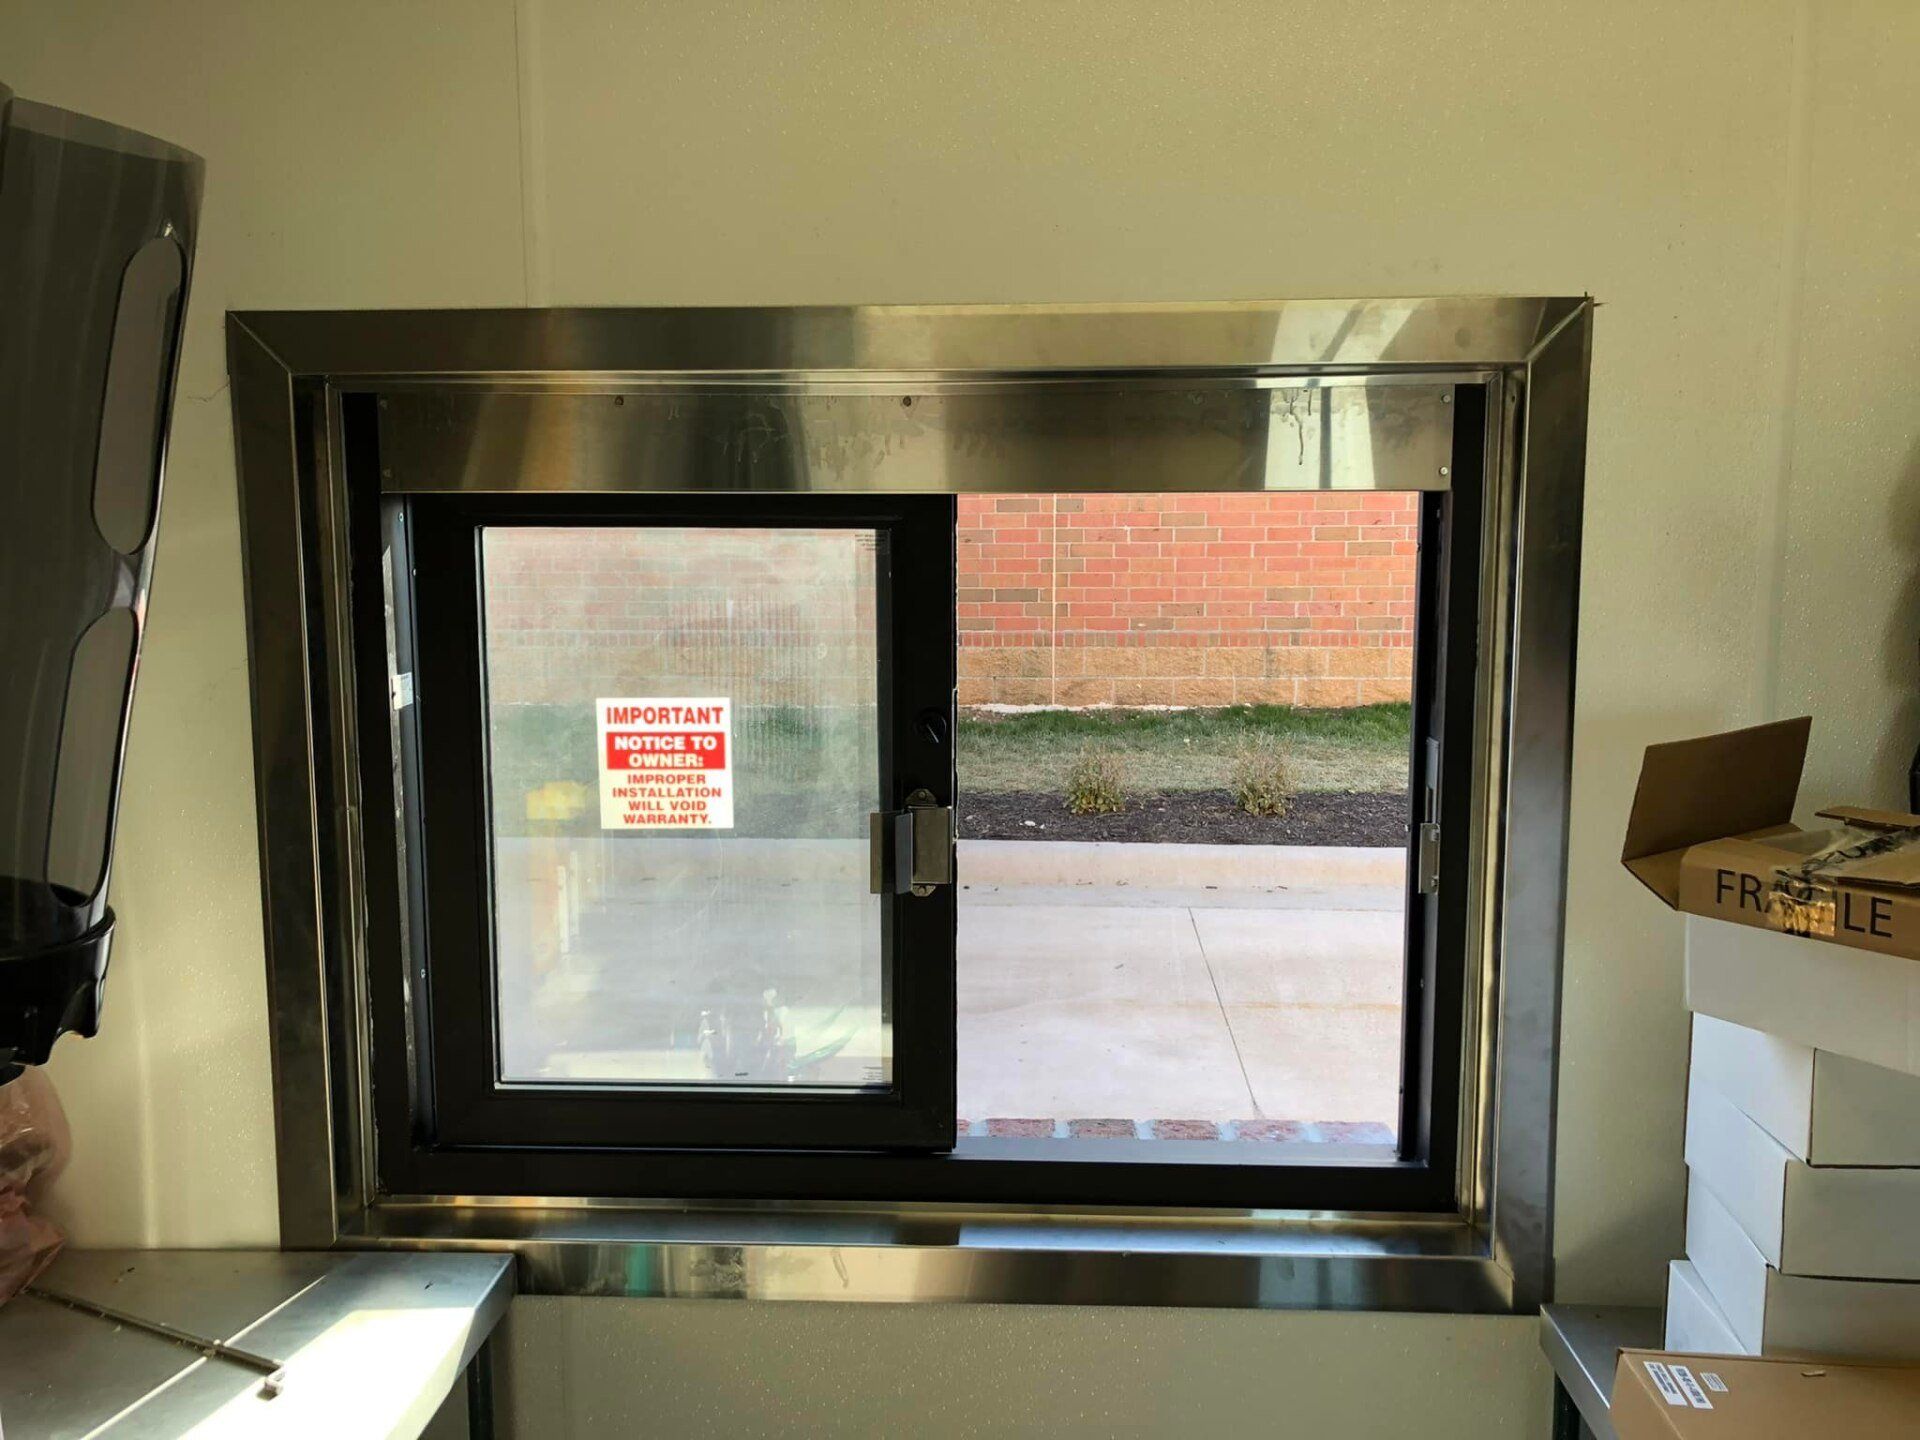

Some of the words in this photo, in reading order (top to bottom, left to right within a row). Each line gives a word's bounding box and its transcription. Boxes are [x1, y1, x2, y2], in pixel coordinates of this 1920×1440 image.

[606, 707, 724, 724] IMPORTANT
[614, 736, 685, 750] NOTICE
[691, 736, 717, 750] TO
[629, 753, 704, 767] OWNER:
[627, 774, 706, 784] IMPROPER
[612, 788, 722, 798] INSTALLATION
[628, 801, 665, 811] WILL
[670, 801, 707, 811] VOID
[623, 814, 712, 824] WARRANTY.
[1716, 868, 1893, 938] FRILE
